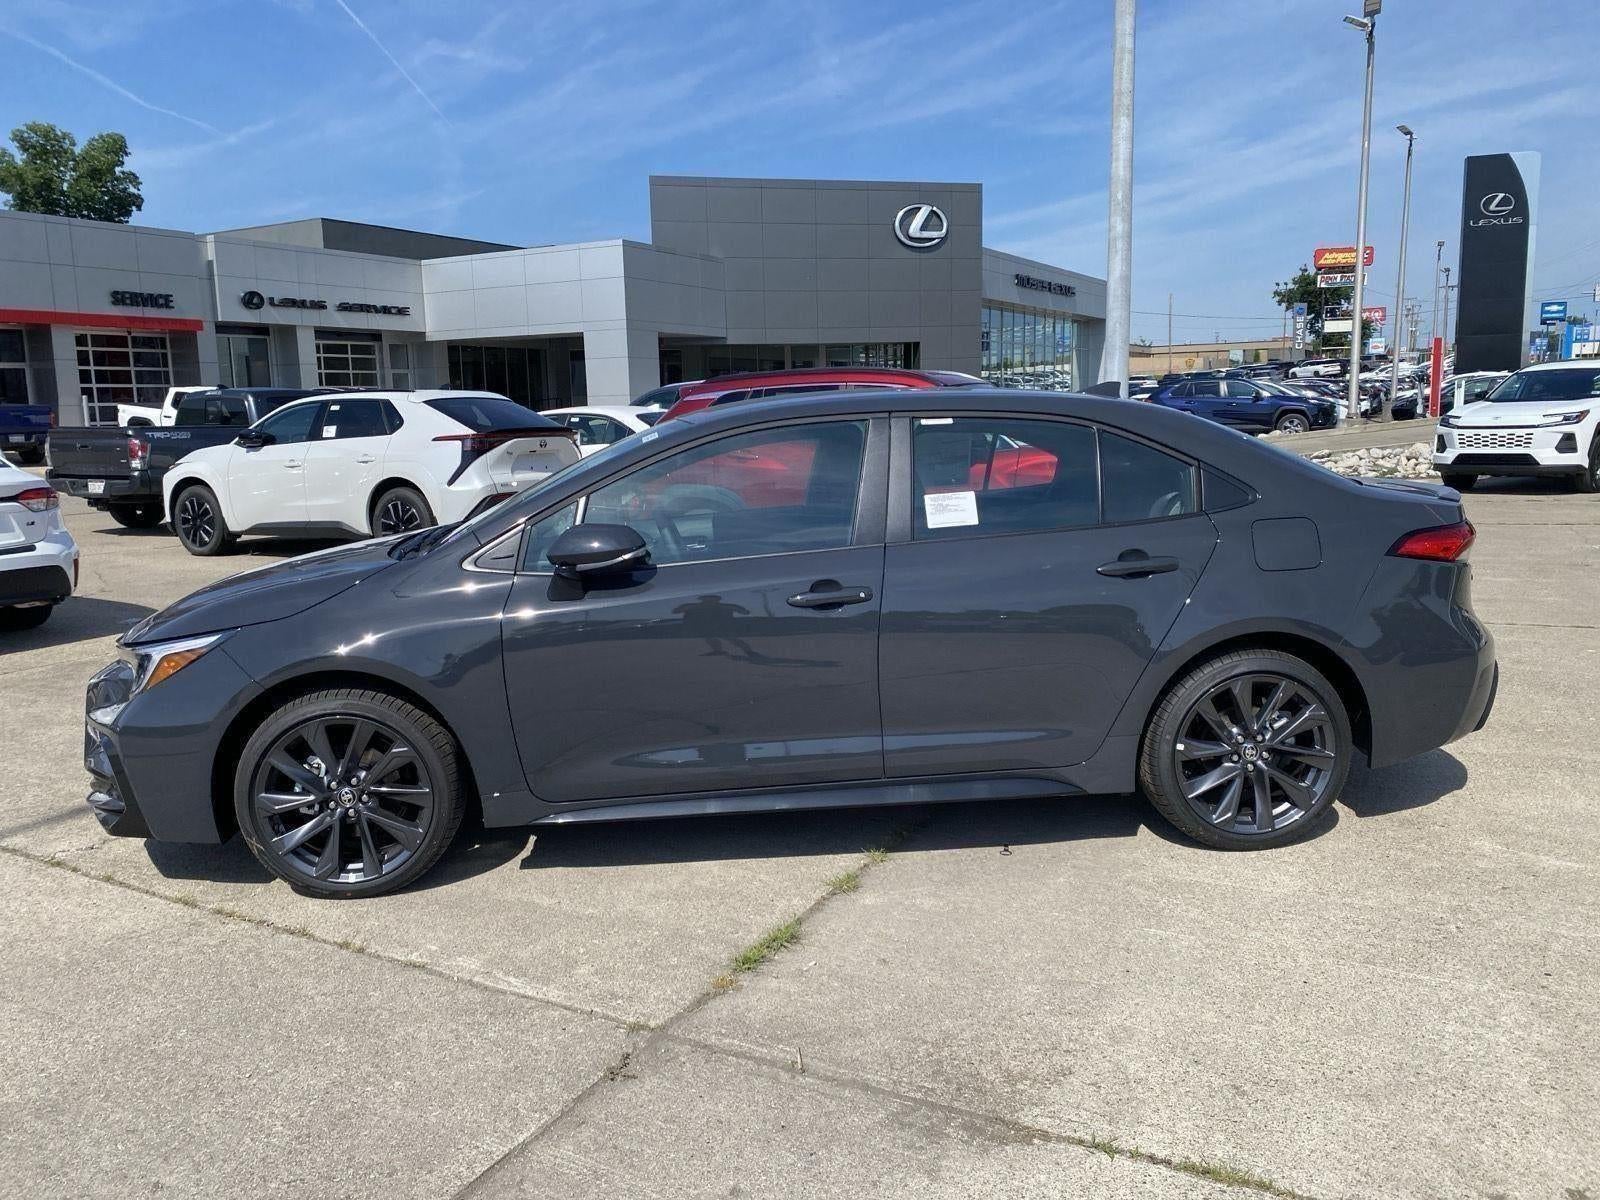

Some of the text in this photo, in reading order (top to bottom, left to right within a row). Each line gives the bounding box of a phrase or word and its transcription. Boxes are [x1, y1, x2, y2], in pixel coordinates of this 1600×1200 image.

[1470, 216, 1523, 227] LEXUS
[111, 290, 175, 309] SERVICE
[268, 297, 411, 316] LEXUS SERVICE
[1295, 316, 1304, 350] CHASE
